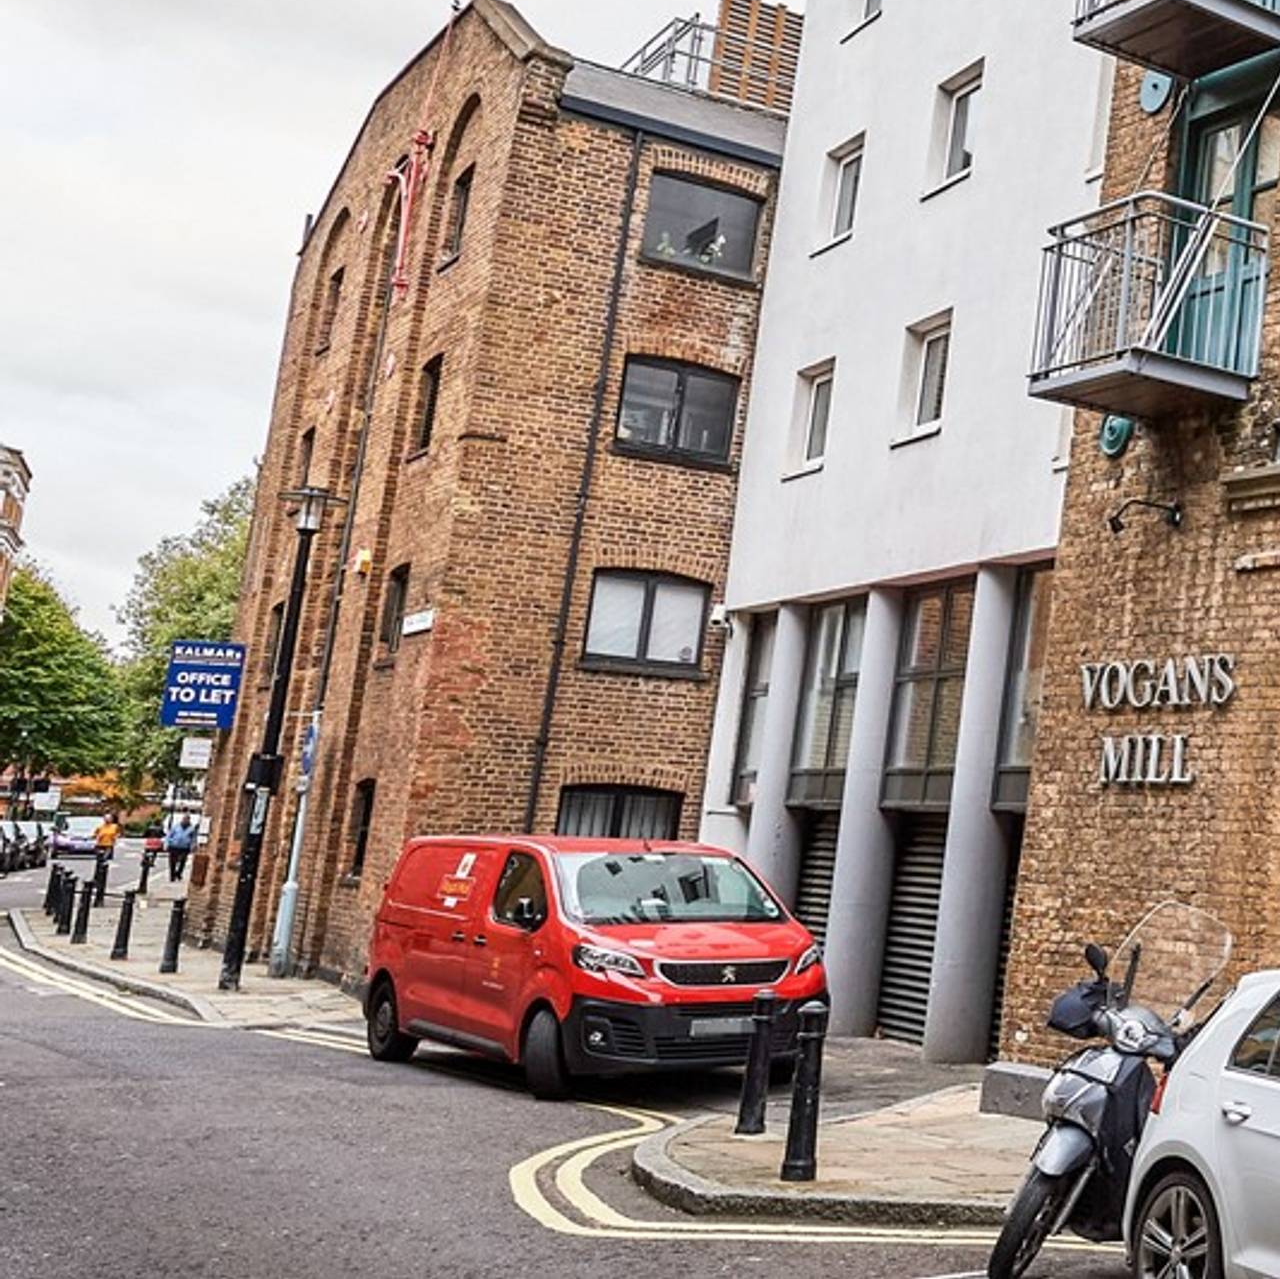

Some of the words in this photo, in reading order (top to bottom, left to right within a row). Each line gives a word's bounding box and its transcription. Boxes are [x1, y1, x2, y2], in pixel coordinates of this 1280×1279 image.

[168, 687, 195, 702] TO
[200, 689, 236, 704] LET
[177, 672, 231, 686] OFFICE
[1081, 653, 1236, 708] VOGANS
[1100, 734, 1194, 784] MILL
